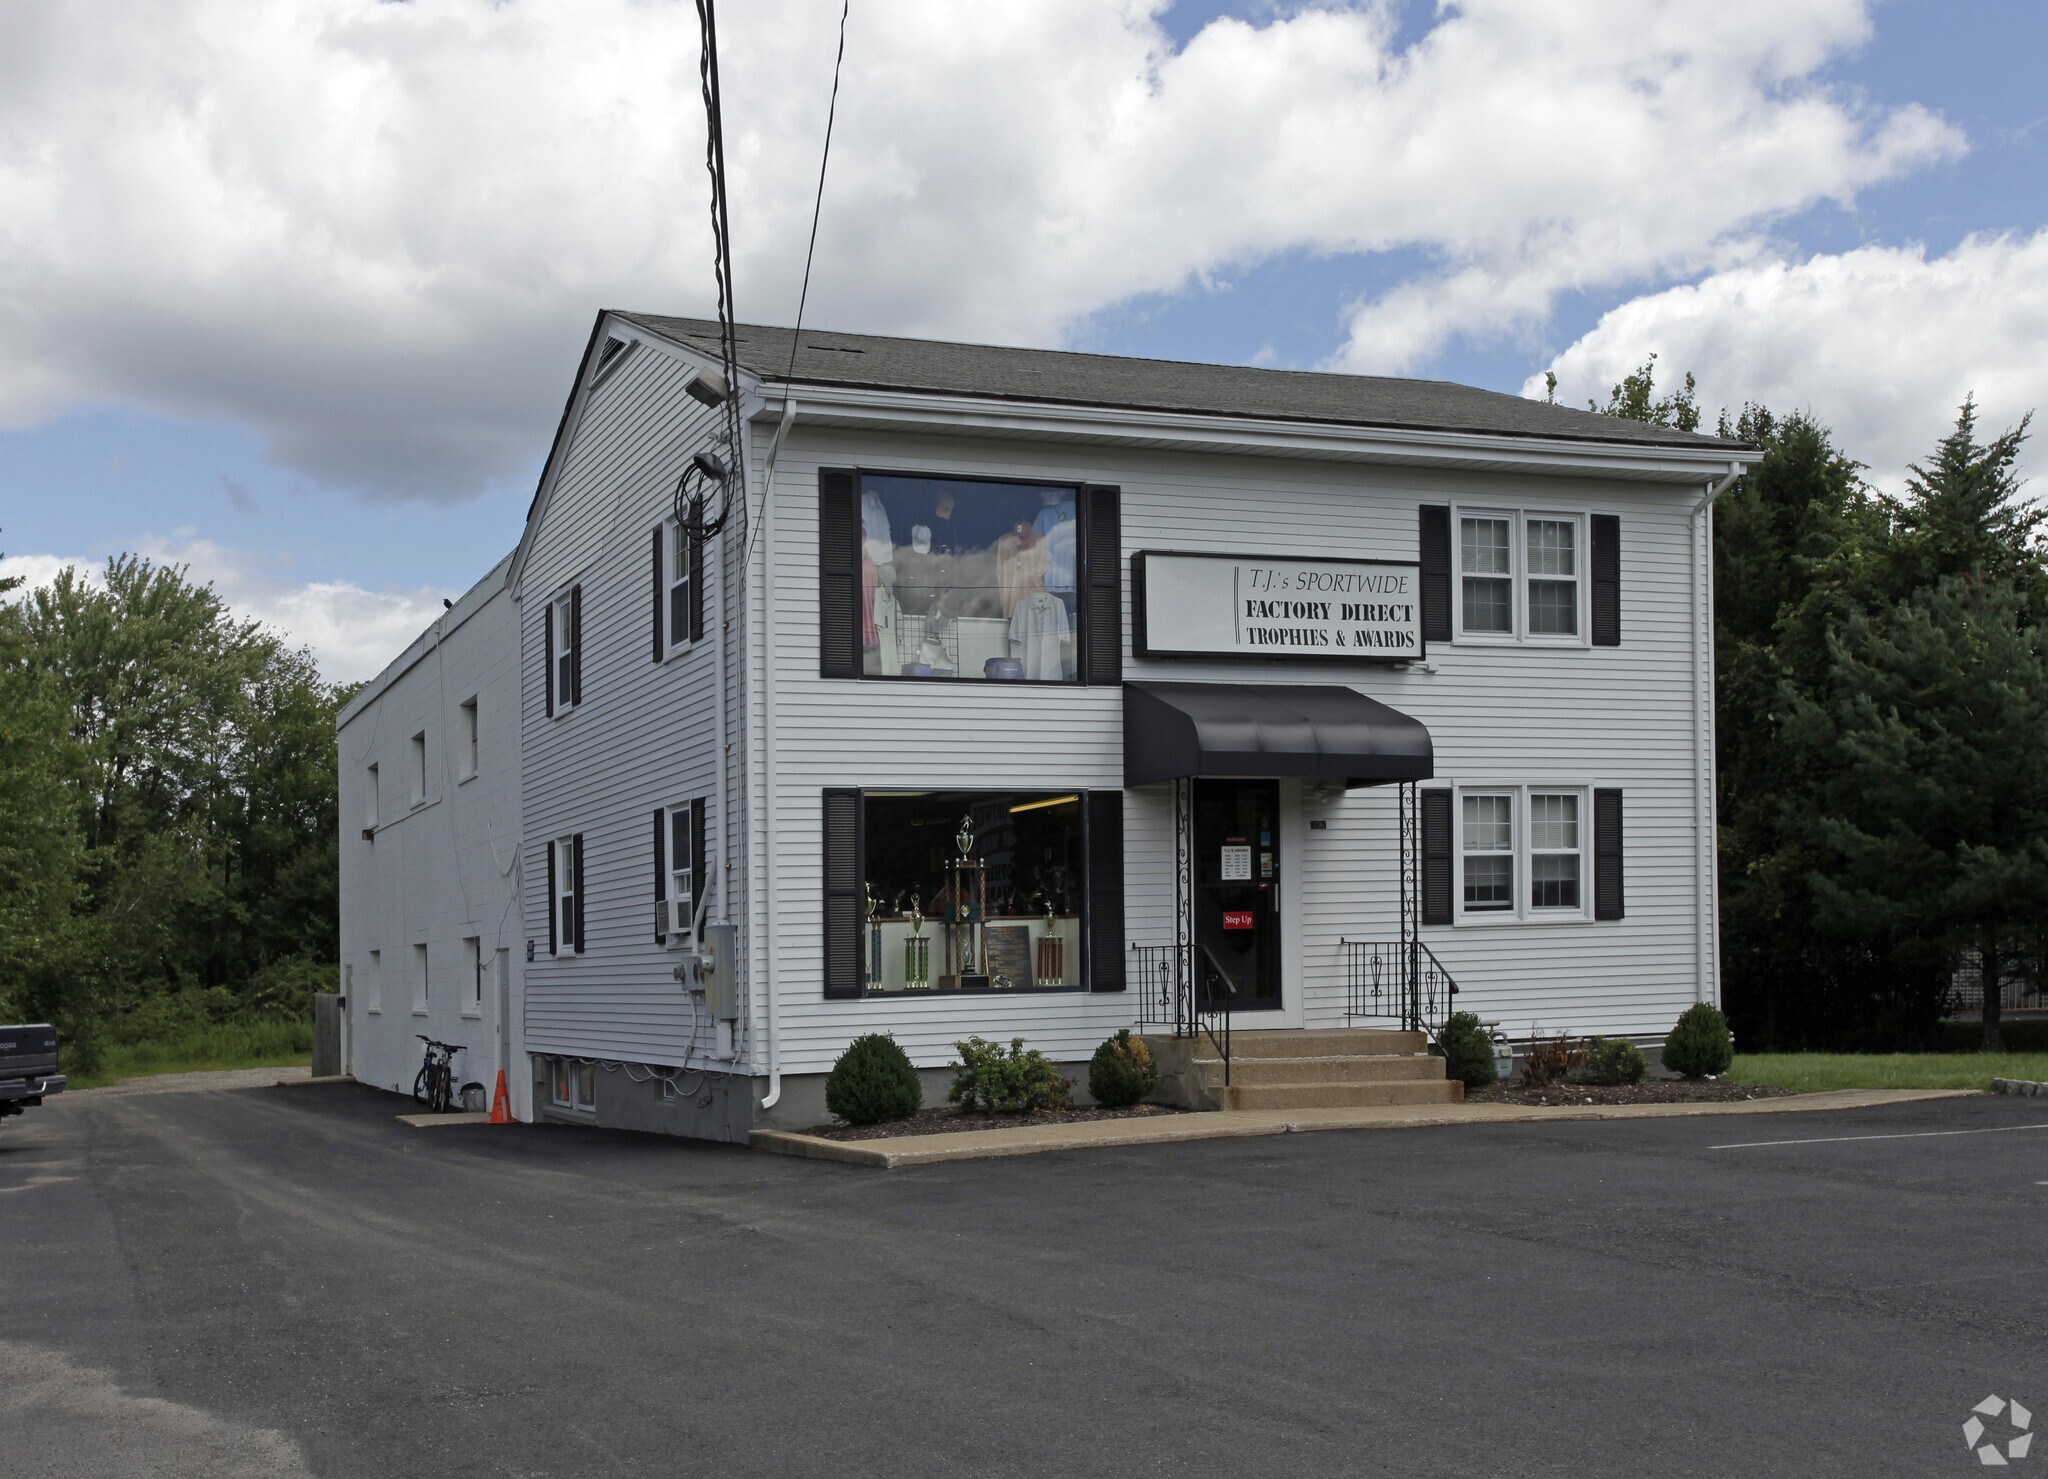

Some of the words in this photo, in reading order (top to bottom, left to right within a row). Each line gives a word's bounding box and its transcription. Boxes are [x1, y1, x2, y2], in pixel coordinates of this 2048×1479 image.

[1296, 572, 1409, 594] SPORTWIDE
[1246, 600, 1332, 620] FACTORY
[1341, 604, 1414, 622] DIRECT
[1247, 628, 1328, 647] TROPHIES
[1335, 630, 1347, 647] &
[1353, 630, 1415, 648] AWARDS
[1225, 915, 1240, 925] Step
[1241, 915, 1252, 925] Up
